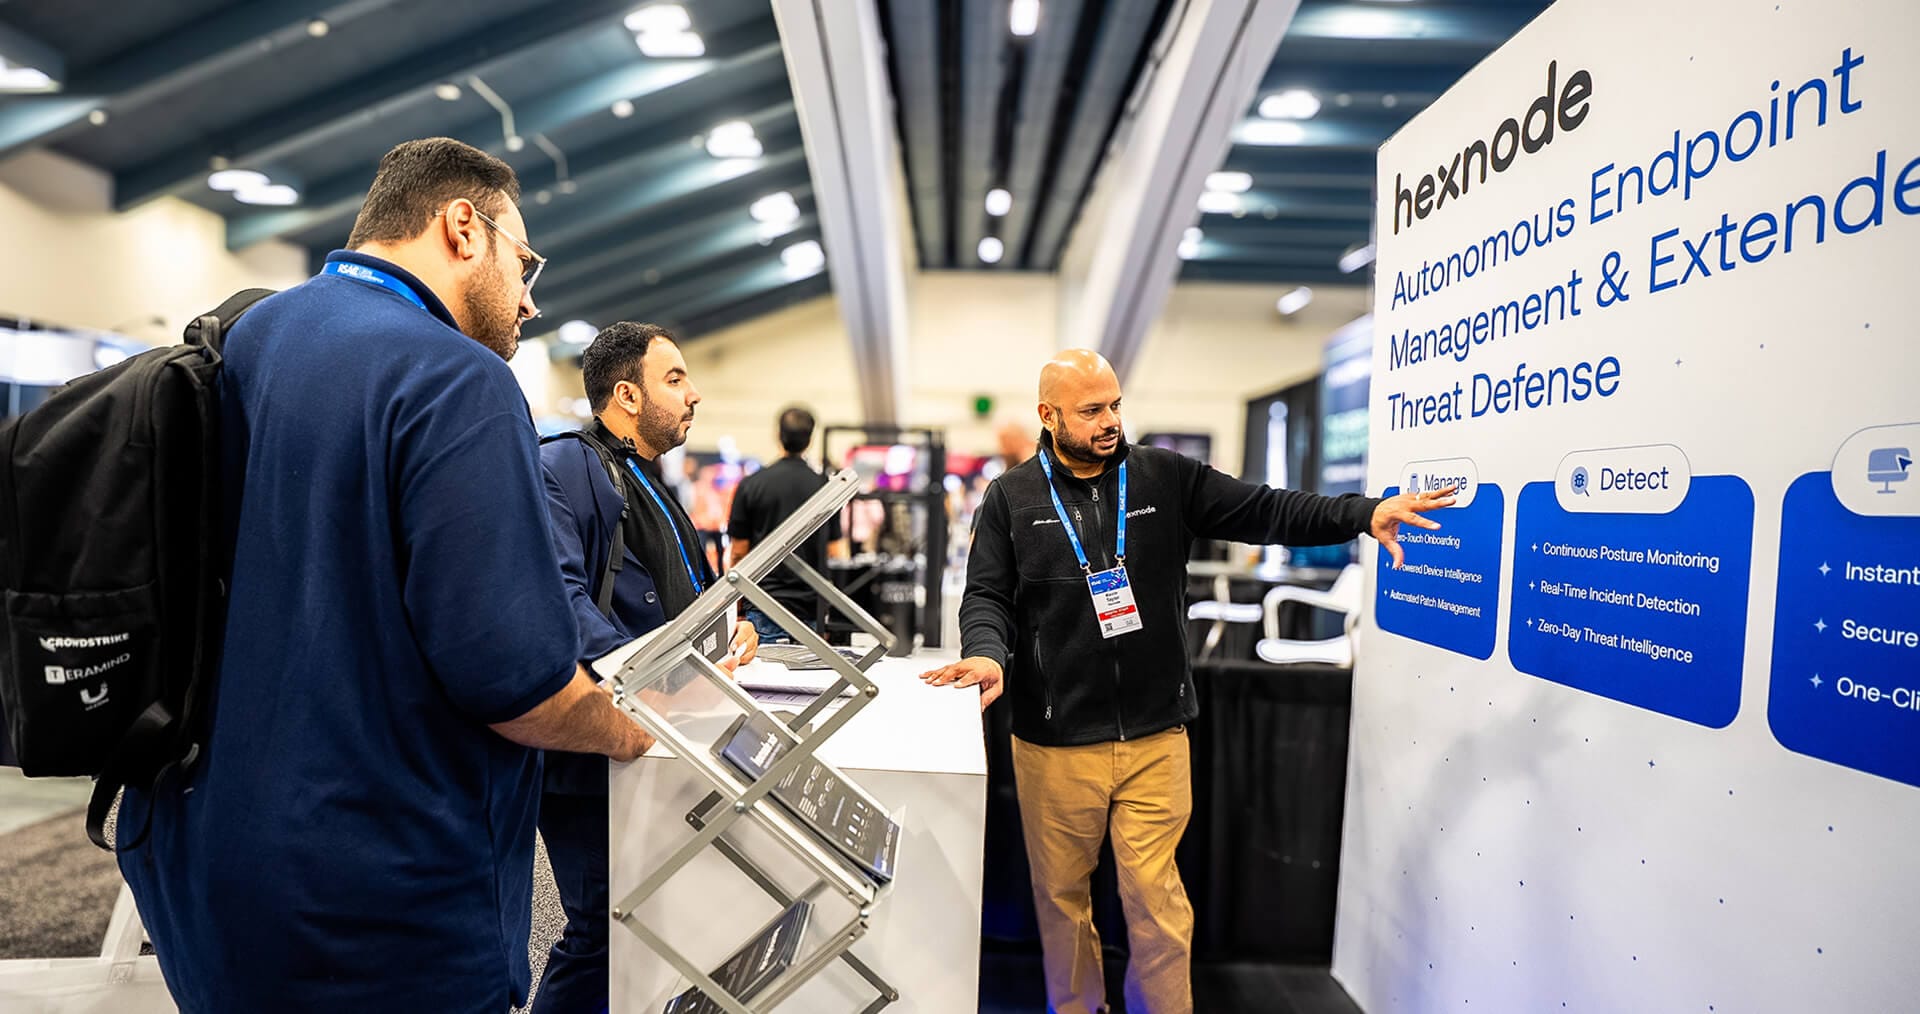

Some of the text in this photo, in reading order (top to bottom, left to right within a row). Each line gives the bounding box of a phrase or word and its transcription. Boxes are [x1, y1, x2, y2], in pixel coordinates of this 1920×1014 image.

[1394, 60, 1593, 235] hexnode
[1391, 47, 1865, 311] Autonomous Endpoint
[1389, 269, 1583, 371] Management
[1596, 250, 1629, 307] &
[1388, 355, 1622, 431] Threat Defense
[1424, 474, 1468, 496] Manage
[1600, 466, 1669, 491] Detect
[1126, 505, 1156, 519] exnode
[1397, 532, 1461, 549] ero-Touch Onboarding
[1543, 542, 1720, 573] Continuous Posture Monitoring
[1424, 564, 1444, 577] Device
[1444, 567, 1482, 583] Intelligence
[1845, 561, 1920, 586] Instant
[1390, 589, 1481, 618] Automated Patch Management
[1540, 580, 1700, 617] Real-Time Incident Detection
[46, 632, 129, 648] CROWDSTRIKE
[1538, 618, 1693, 664] Zero-Day Threat Intelligence
[1841, 619, 1919, 648] Secure
[45, 653, 130, 684] TERAMIND
